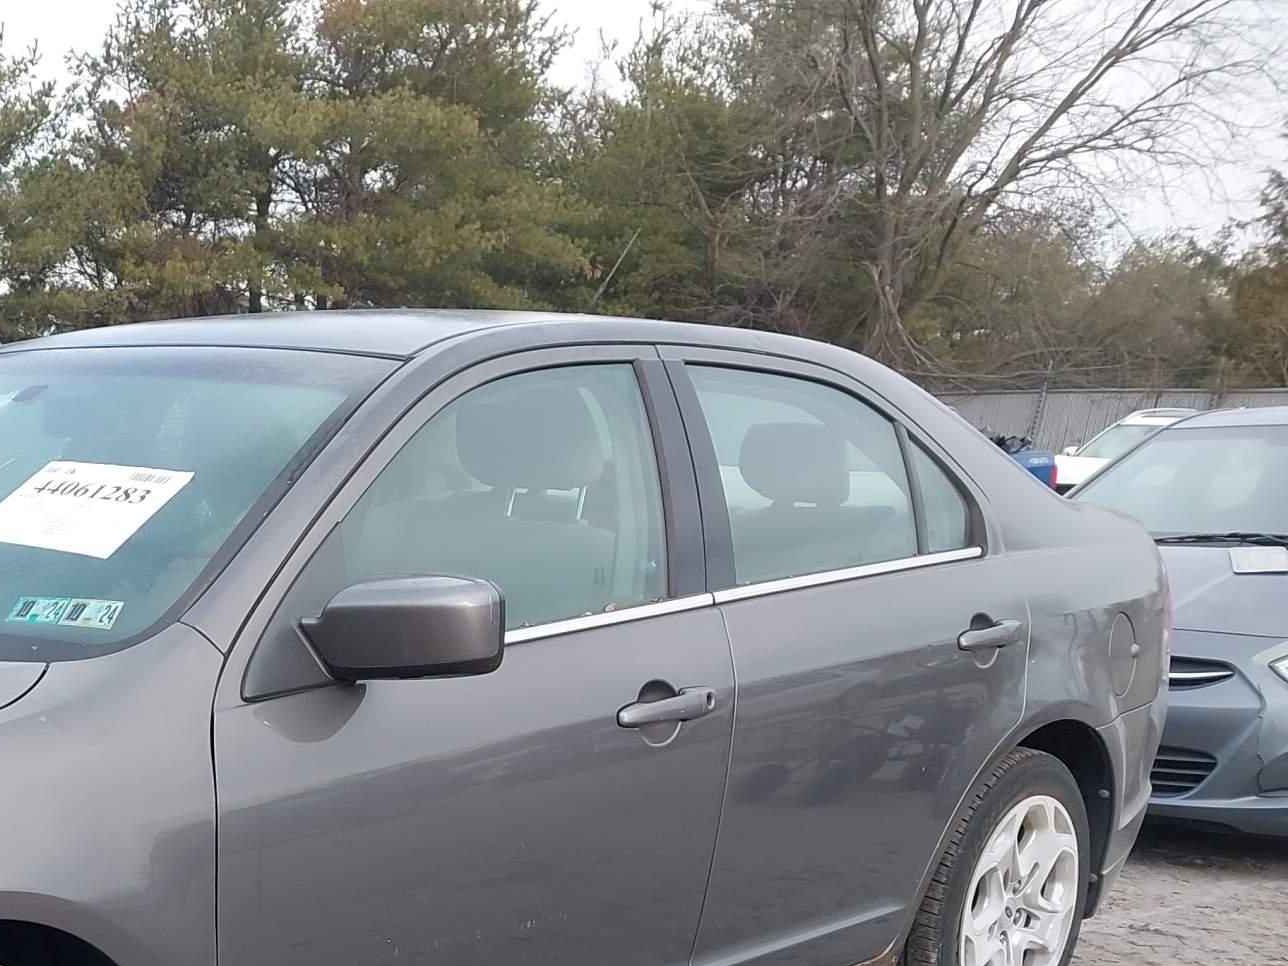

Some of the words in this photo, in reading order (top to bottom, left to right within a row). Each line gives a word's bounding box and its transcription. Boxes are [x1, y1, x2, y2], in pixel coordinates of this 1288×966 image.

[34, 479, 151, 504] 44061283
[45, 601, 65, 619] 24
[99, 605, 118, 625] 24
